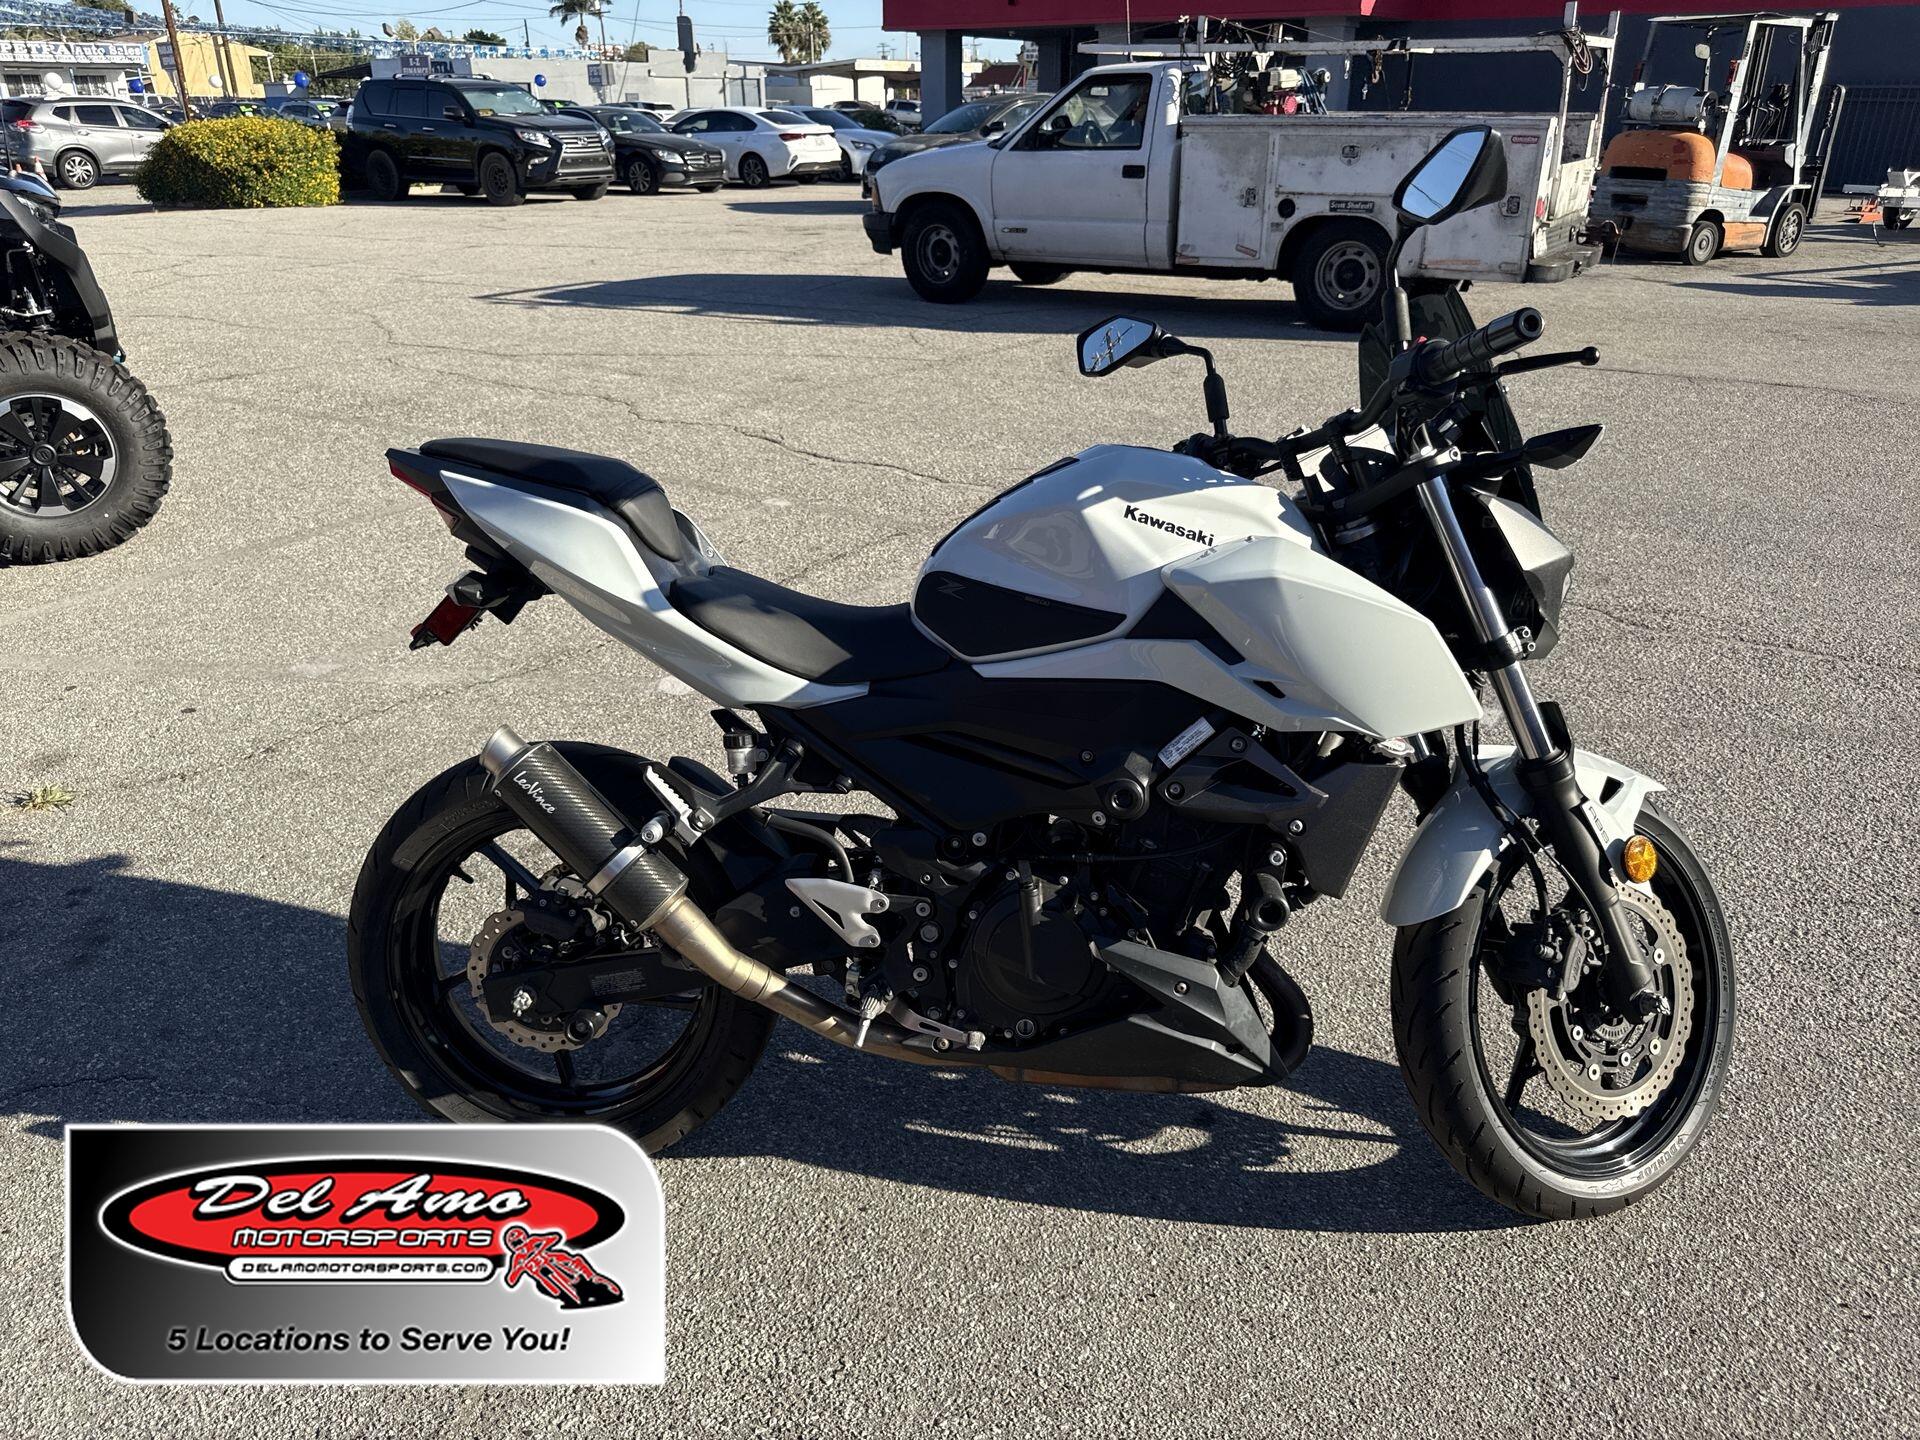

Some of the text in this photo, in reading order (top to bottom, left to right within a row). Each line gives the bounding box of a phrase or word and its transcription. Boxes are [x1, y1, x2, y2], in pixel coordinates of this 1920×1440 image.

[0, 42, 141, 56] PETRA Auto Sales
[1123, 504, 1215, 547] Kawasaki
[513, 770, 556, 814] LeoVince
[1588, 806, 1610, 844] ABS
[1636, 1145, 1678, 1181] DUNLOP
